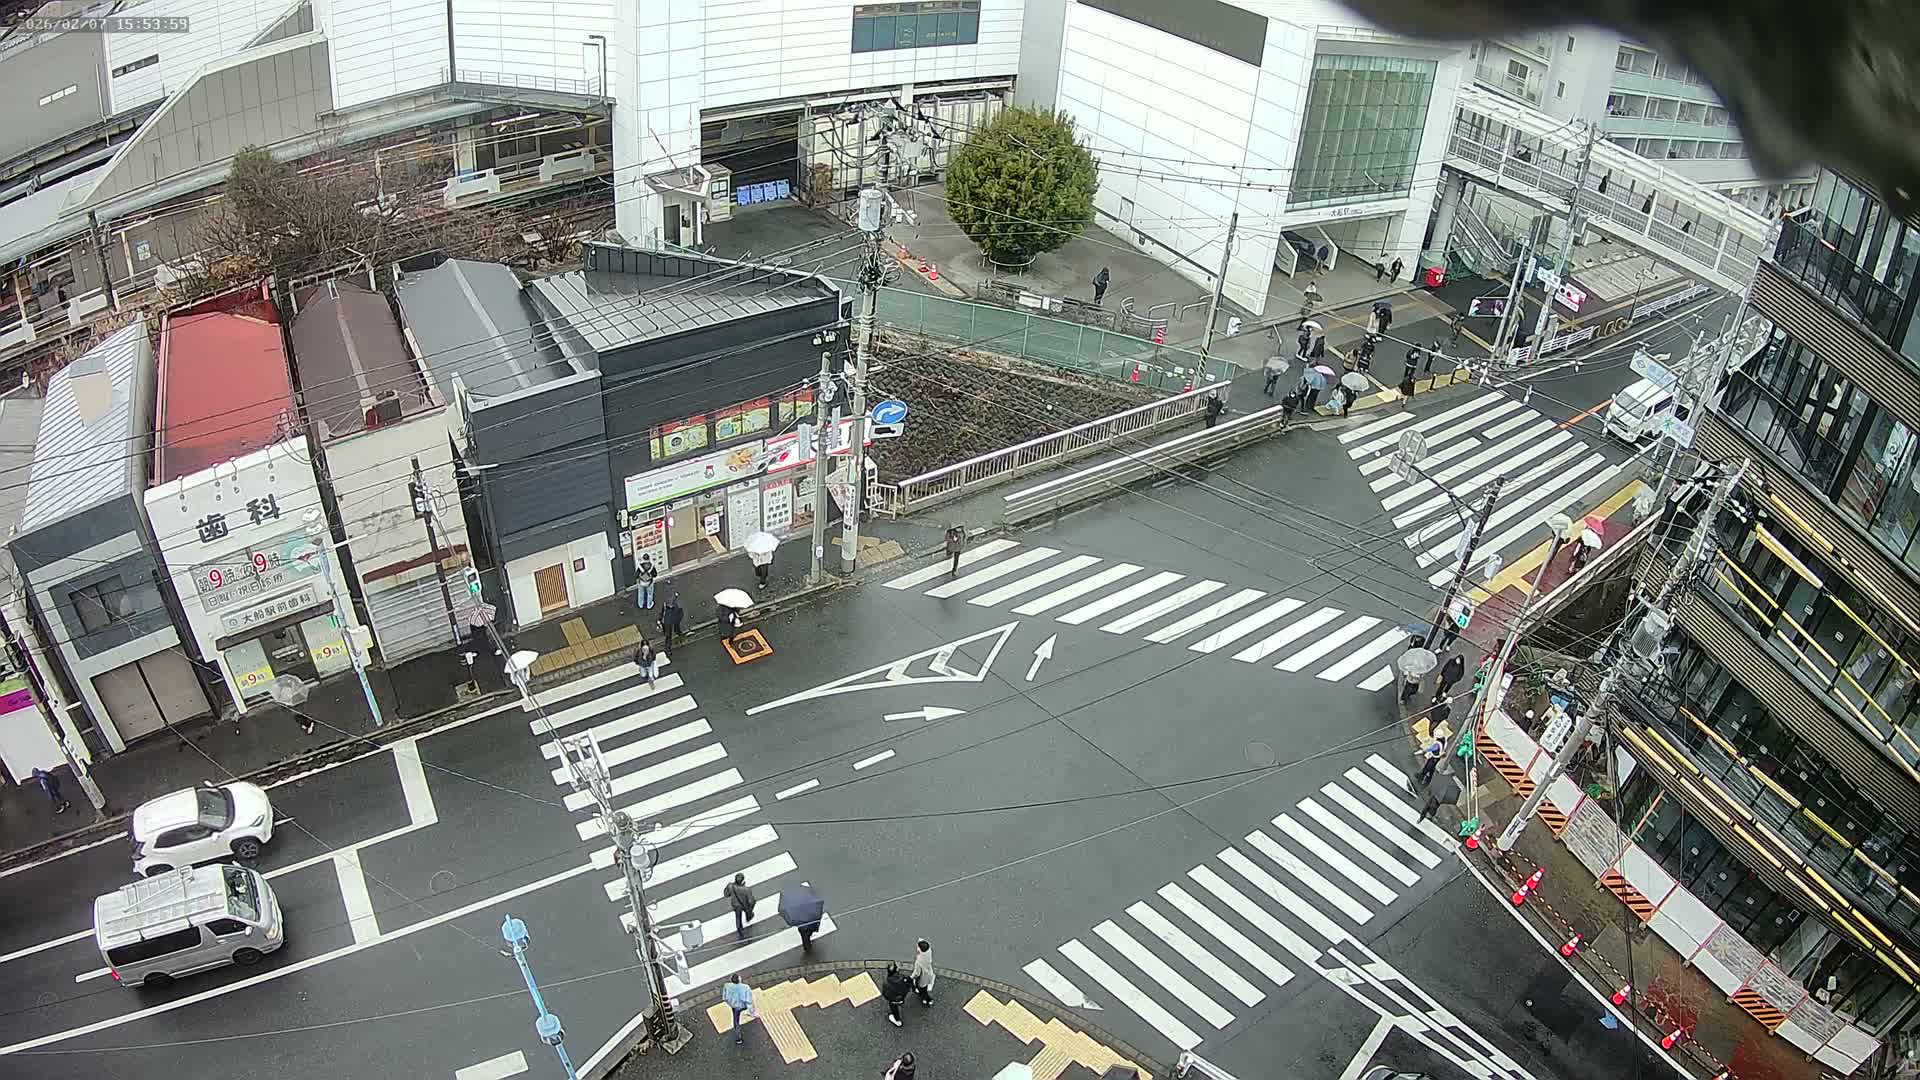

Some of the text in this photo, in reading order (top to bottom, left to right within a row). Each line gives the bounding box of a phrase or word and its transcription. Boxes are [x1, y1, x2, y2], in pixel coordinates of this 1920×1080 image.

[196, 493, 280, 543] 歯科
[242, 594, 311, 625] 大船駅前歯科
